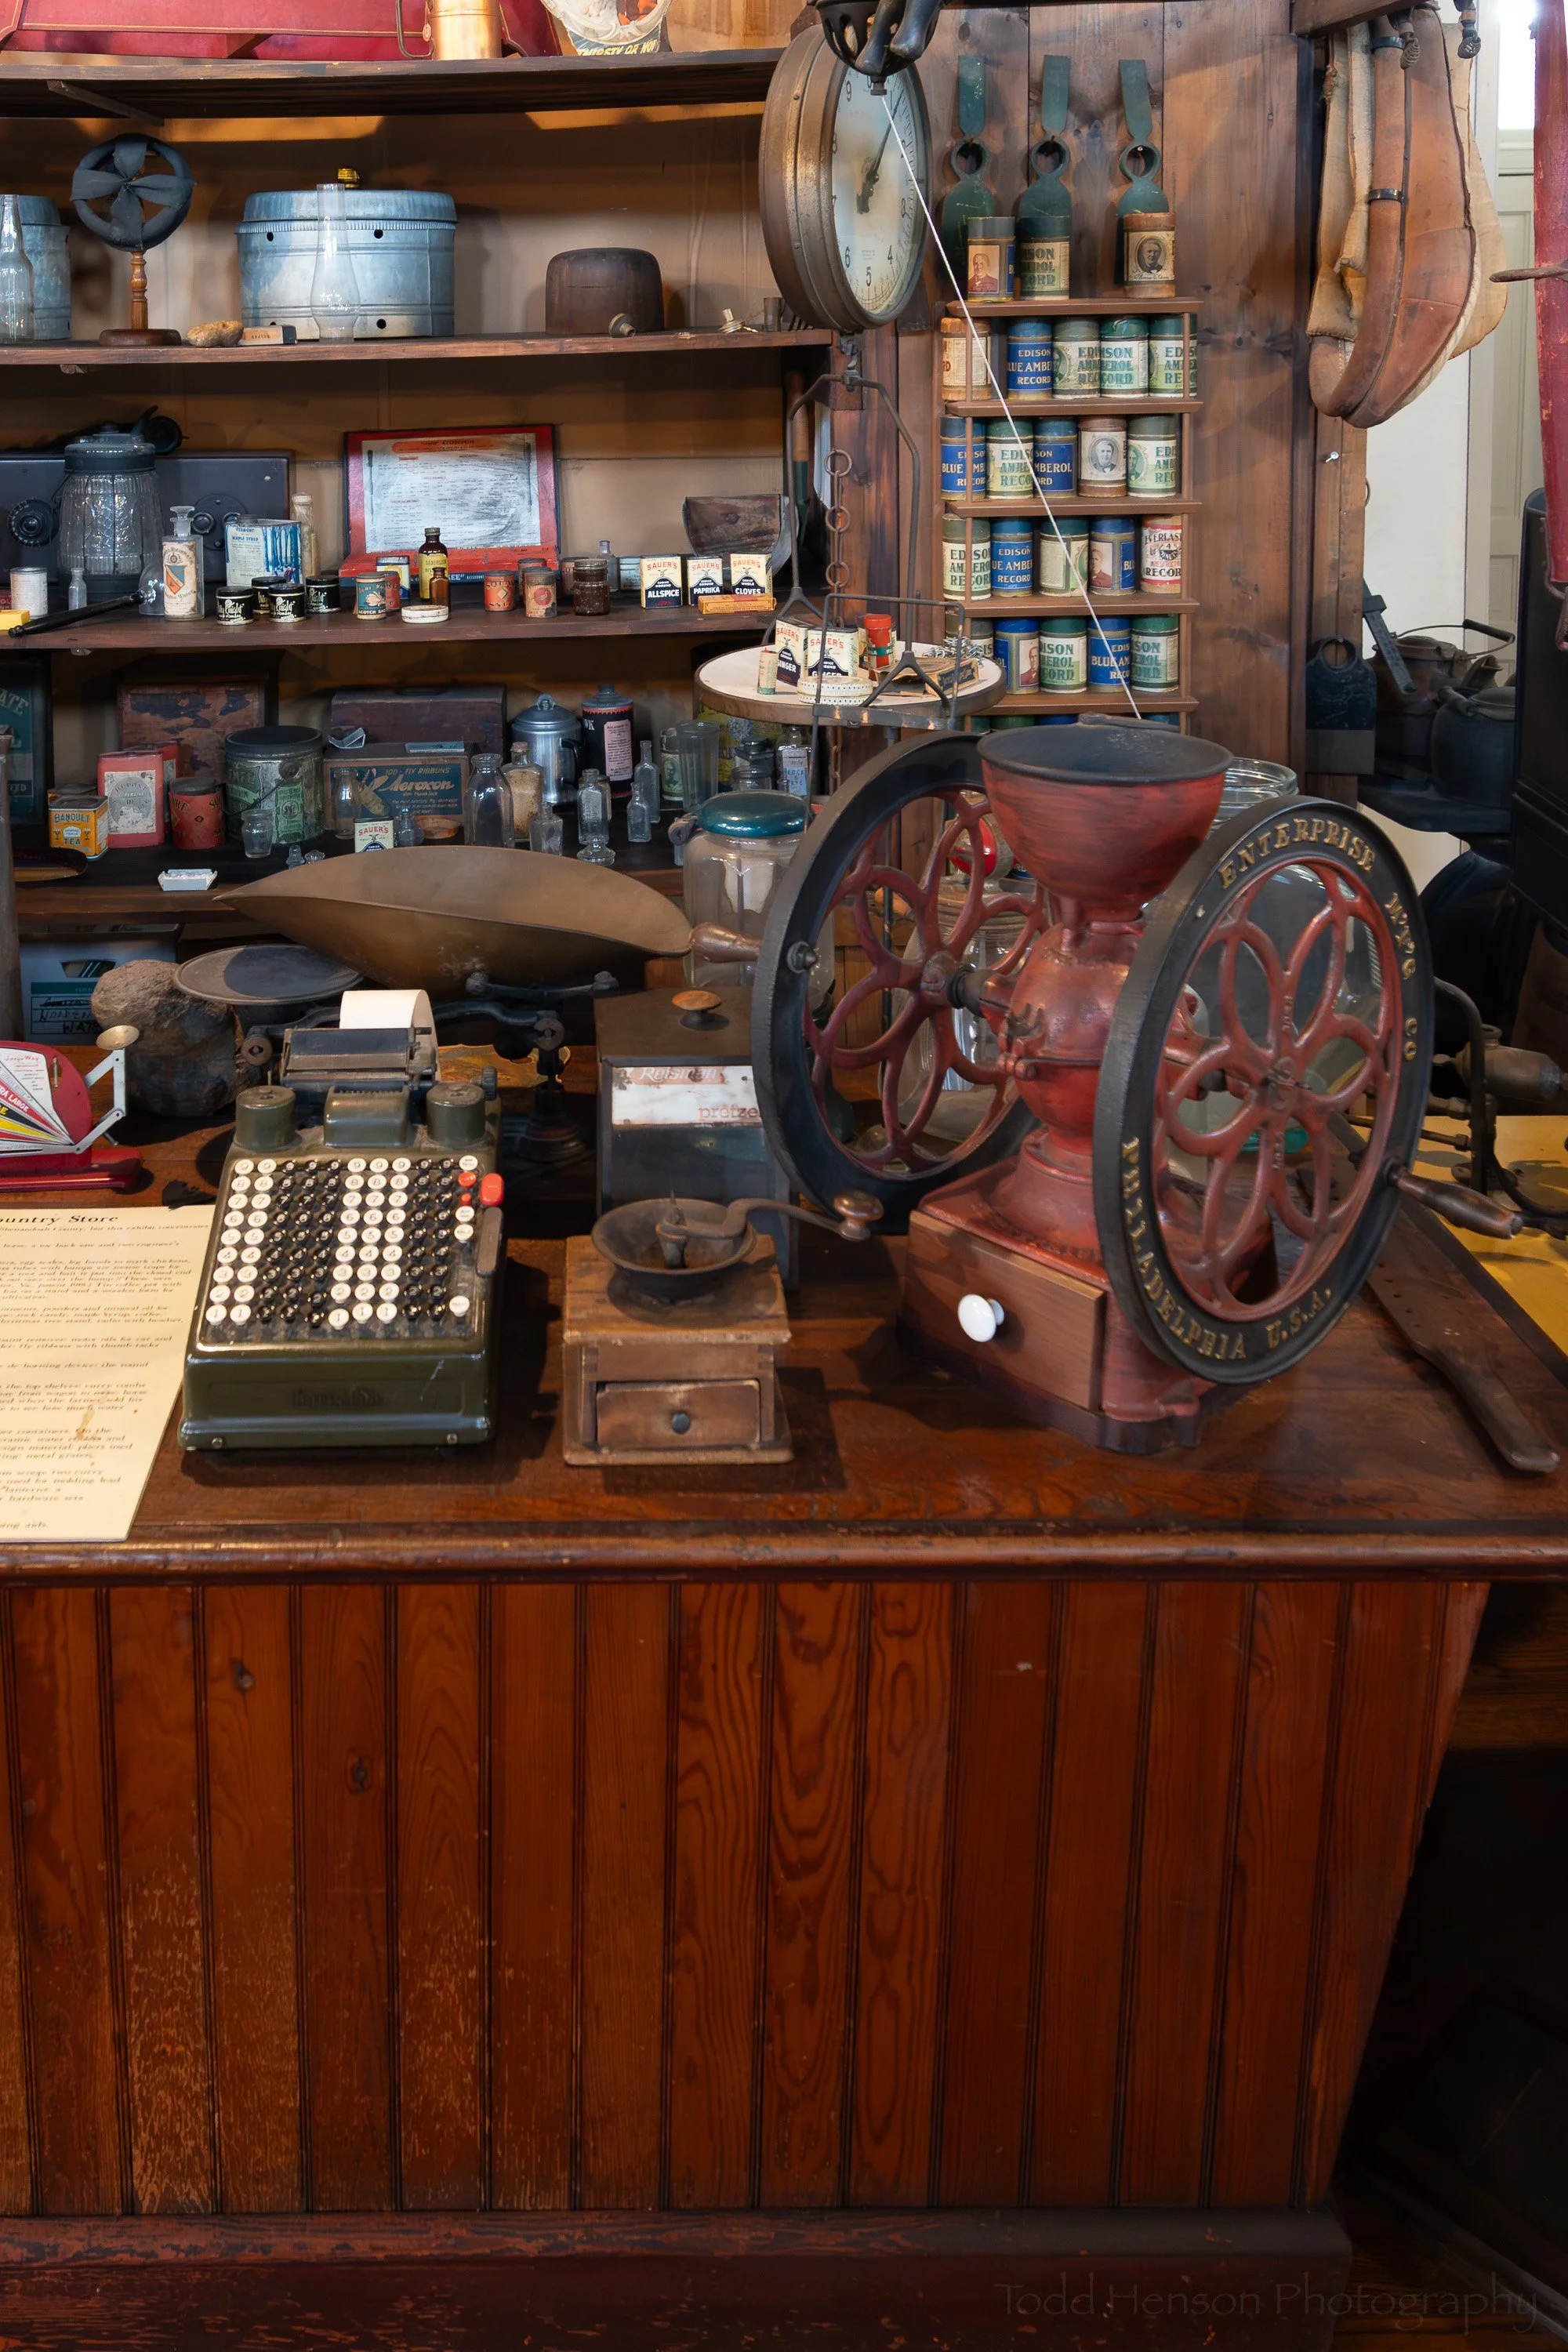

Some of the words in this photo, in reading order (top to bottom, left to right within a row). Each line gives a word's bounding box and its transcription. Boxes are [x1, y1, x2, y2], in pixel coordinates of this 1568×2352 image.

[626, 45, 637, 54] OR
[846, 81, 851, 102] 9
[844, 246, 851, 268] 6
[887, 245, 893, 265] 4
[866, 267, 872, 287] 5
[1008, 362, 1023, 372] LUE
[1025, 362, 1052, 372] AMBE
[942, 463, 964, 474] BLUE
[1035, 463, 1072, 473] MBEROL
[1145, 532, 1181, 545] EVERLAS
[647, 561, 678, 571] SAUER'S
[691, 561, 720, 571] SAUER'S
[732, 558, 760, 568] SAUER'S
[1005, 561, 1033, 571] AMBE
[1145, 568, 1181, 577] RECOR
[648, 590, 680, 598] ALLSPICE
[776, 627, 800, 641] SAUER'S
[810, 638, 844, 648] SAER'S
[777, 659, 797, 673] GINGER
[1091, 656, 1116, 666] BLUE
[0, 689, 29, 716] ATE
[379, 774, 455, 792] Aeroxon
[54, 813, 90, 823] BANQUET
[358, 826, 390, 837] SAUER'S
[1218, 817, 1377, 889] ENTERPRISE
[8, 1094, 30, 1112] LARGE
[698, 1103, 759, 1121] pretze
[68, 1214, 119, 1223] Store
[1122, 1136, 1247, 1360] PHILADELPHIA
